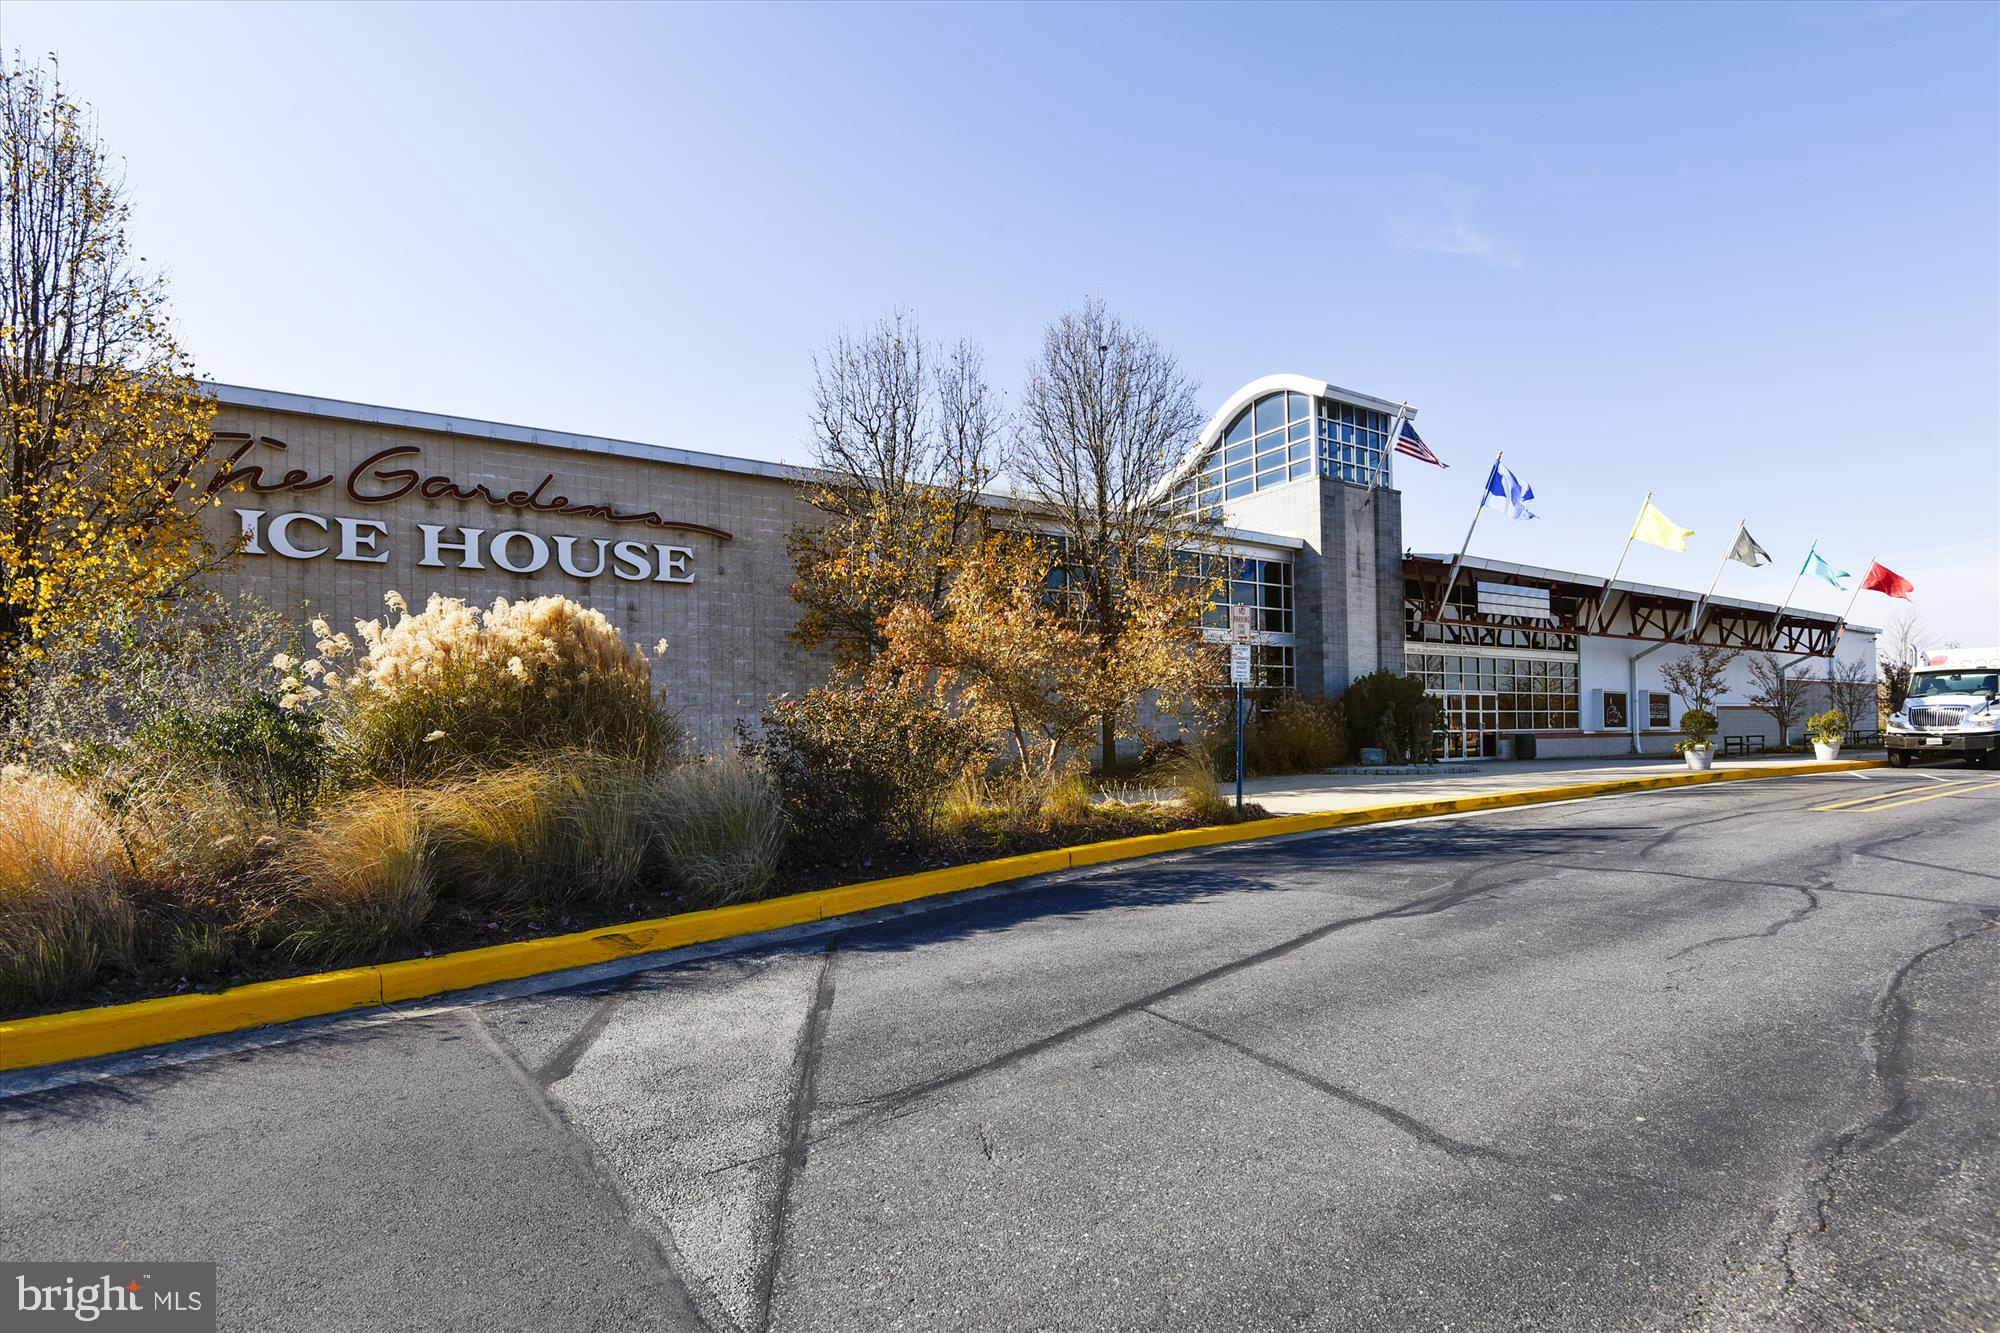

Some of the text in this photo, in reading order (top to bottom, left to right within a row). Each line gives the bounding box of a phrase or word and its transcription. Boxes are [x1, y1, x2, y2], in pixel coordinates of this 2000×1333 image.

[158, 432, 733, 540] The Gardens
[234, 508, 696, 584] ICE HOUSE
[1233, 615, 1251, 623] PARKING
